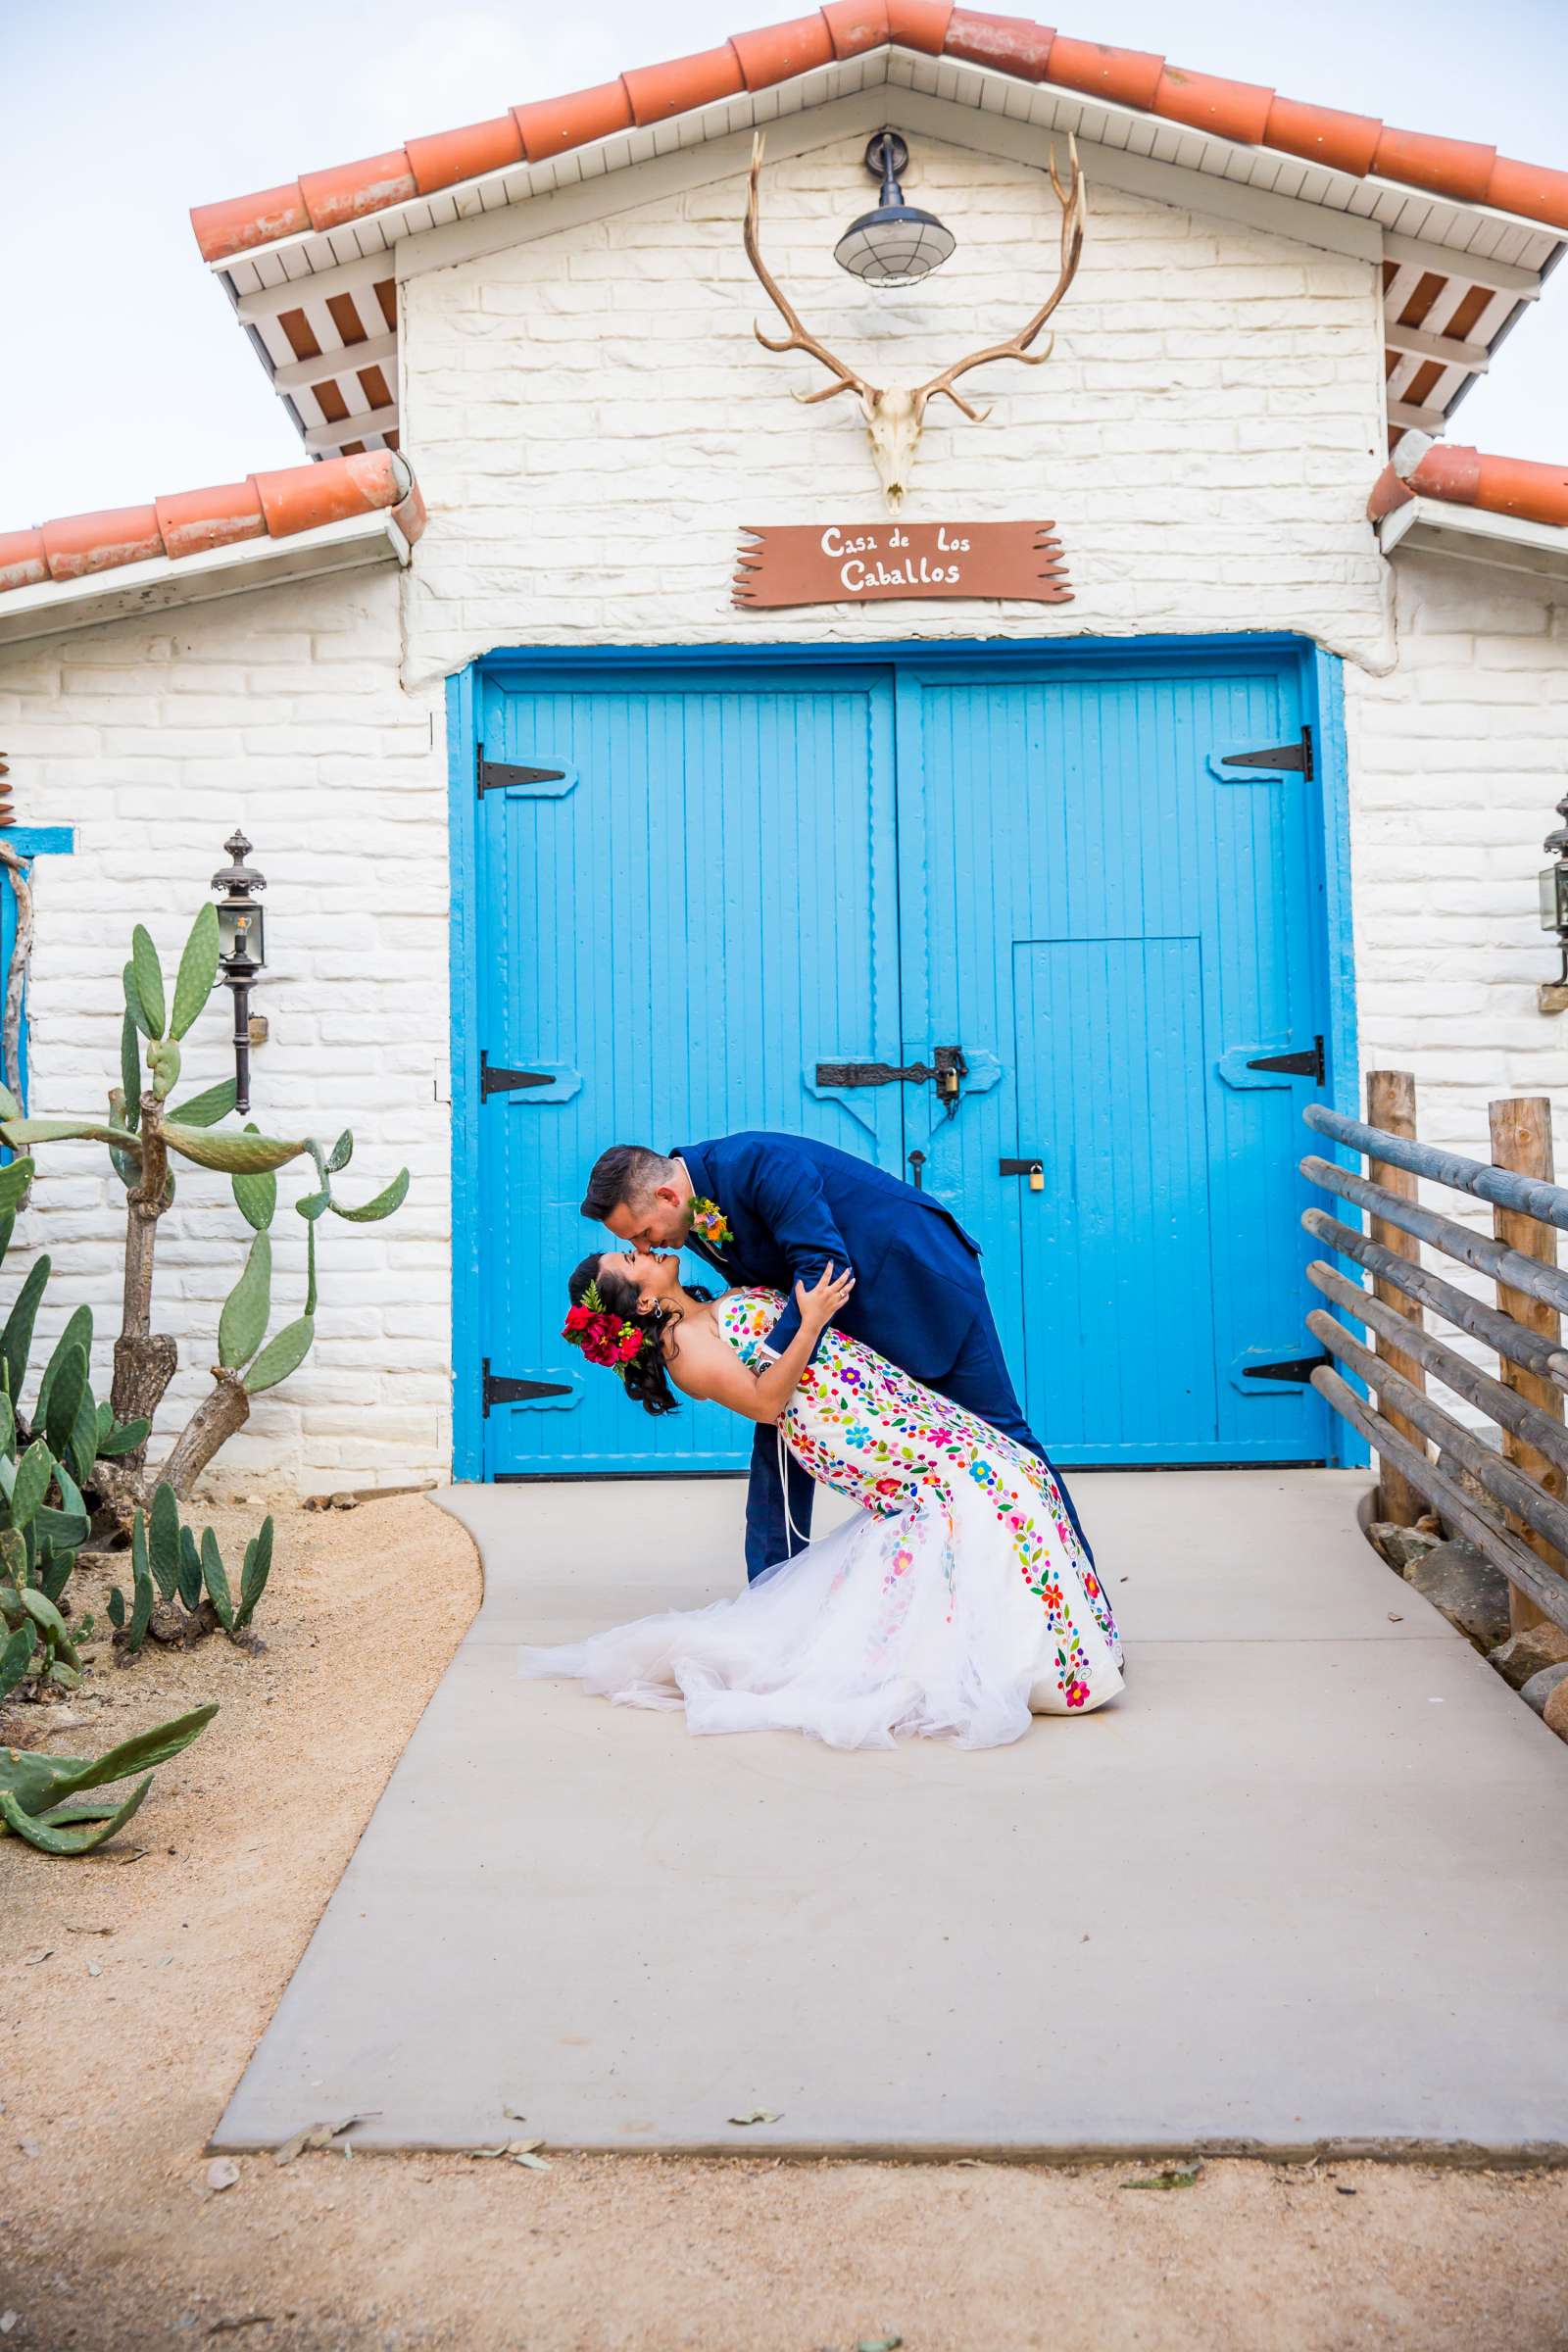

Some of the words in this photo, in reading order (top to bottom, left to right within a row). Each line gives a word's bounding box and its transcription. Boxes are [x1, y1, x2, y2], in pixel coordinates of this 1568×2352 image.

[820, 527, 877, 558] Casa
[888, 527, 909, 548] de
[937, 527, 970, 552] Los
[840, 557, 960, 592] Caballos
